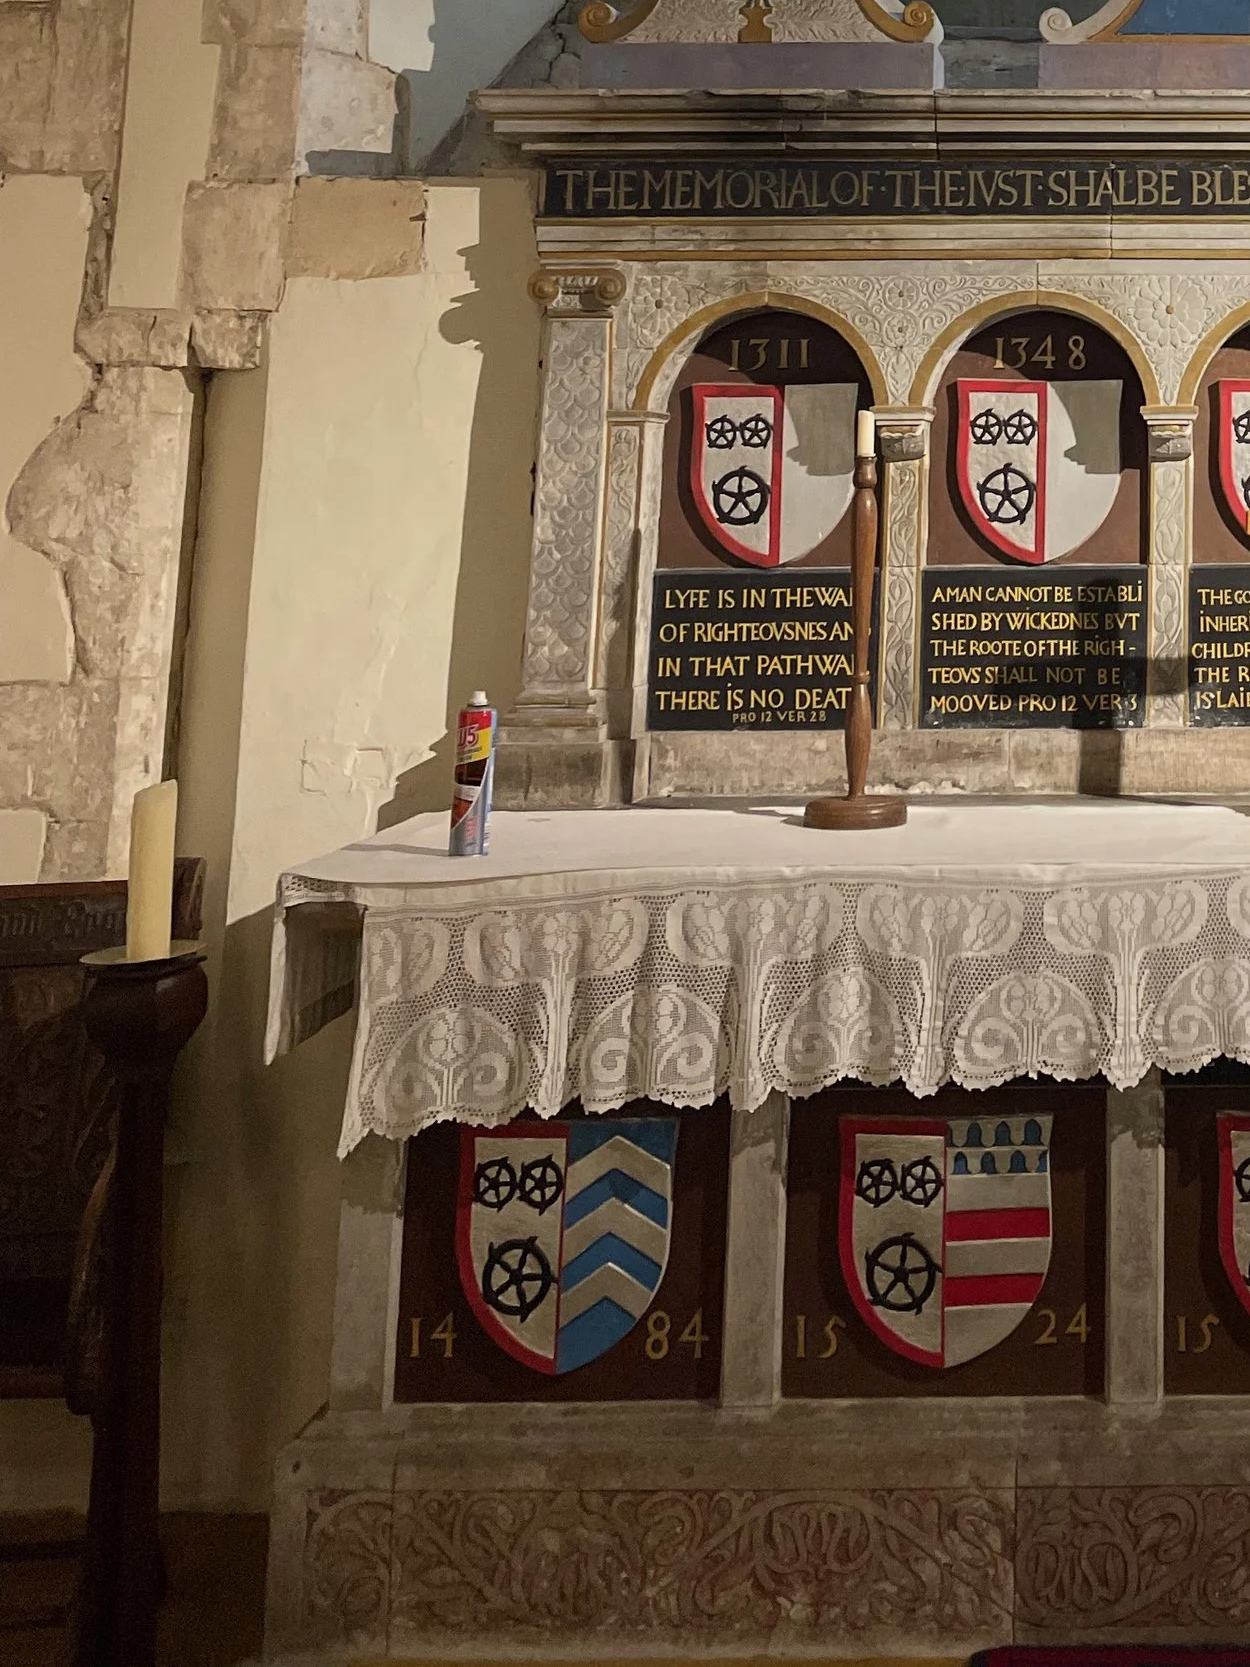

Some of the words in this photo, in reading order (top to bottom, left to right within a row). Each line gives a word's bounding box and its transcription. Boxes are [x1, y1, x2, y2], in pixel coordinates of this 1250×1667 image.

[556, 169, 640, 212] THE
[830, 168, 875, 209] OF
[886, 170, 962, 210] THE
[728, 337, 809, 371] 1311
[994, 335, 1086, 370] 1348
[665, 589, 710, 609] LYFE
[718, 590, 735, 608] IS
[743, 588, 765, 608] IN
[770, 588, 814, 608] THE
[931, 587, 946, 602] A
[946, 586, 982, 602] MAN
[985, 586, 1052, 602] CANNOT
[1054, 587, 1072, 602] BE
[1197, 589, 1232, 605] THE
[659, 623, 690, 642] OF
[694, 621, 827, 642] RIGHTEOVSNES
[931, 613, 977, 631] SHED
[980, 613, 1003, 631] BY
[1105, 613, 1140, 630] BVT
[930, 639, 966, 656] THE
[969, 640, 1021, 656] ROOTE
[1024, 640, 1045, 657] OF
[1047, 640, 1079, 656] THE
[658, 658, 681, 677] IN
[689, 656, 750, 677] THAT
[928, 667, 981, 684] TEOVS
[985, 666, 1038, 684] SHALL
[1046, 668, 1085, 683] NOT
[1097, 668, 1121, 684] BE
[1194, 667, 1230, 683] THE
[655, 690, 720, 710] THERE
[727, 683, 743, 711] IS
[750, 688, 784, 708] NO
[795, 687, 852, 710] DEAT
[930, 695, 1011, 714] MOOVED
[1019, 694, 1056, 712] PRO
[1061, 695, 1078, 711] 12
[1082, 695, 1122, 711] VER
[733, 713, 756, 723] PRO
[760, 711, 772, 722] 12
[777, 711, 806, 722] VER
[809, 711, 826, 722] 28
[408, 1313, 456, 1359] 14
[646, 1310, 708, 1360] 84
[797, 1313, 848, 1360] 15
[1034, 1307, 1090, 1345] 24
[1175, 1314, 1221, 1354] 15
